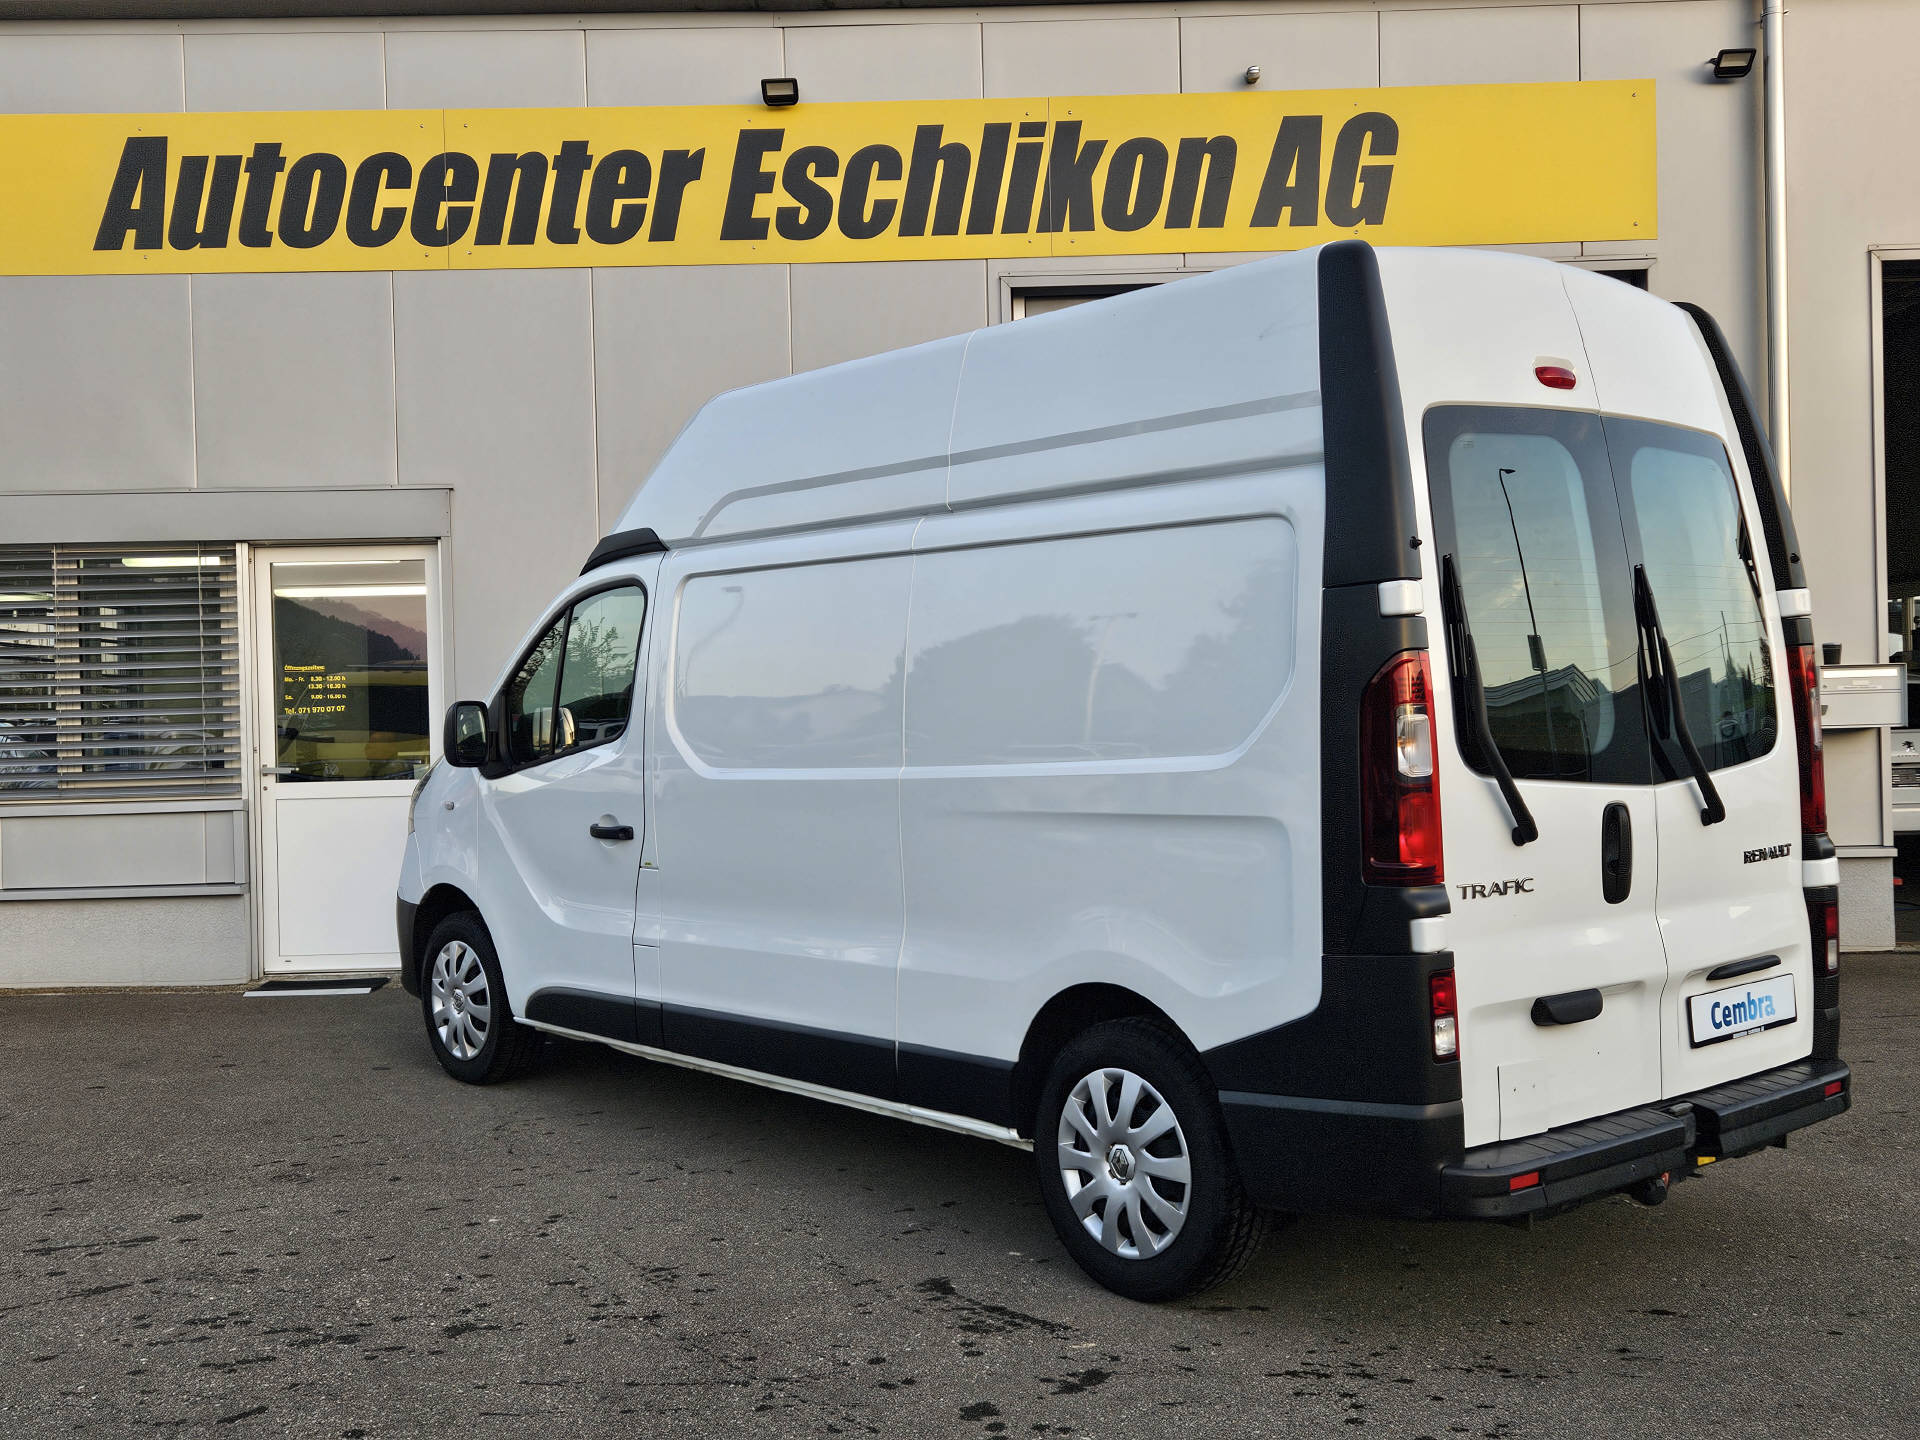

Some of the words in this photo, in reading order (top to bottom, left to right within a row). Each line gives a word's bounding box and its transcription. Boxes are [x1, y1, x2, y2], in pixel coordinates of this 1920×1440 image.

[93, 136, 705, 251] Autocenter
[720, 120, 1237, 241] Eschlikon
[1249, 112, 1399, 228] AG
[1743, 843, 1792, 864] RENAULT
[1456, 877, 1534, 900] TRAFIC
[1711, 991, 1776, 1030] Cembra
